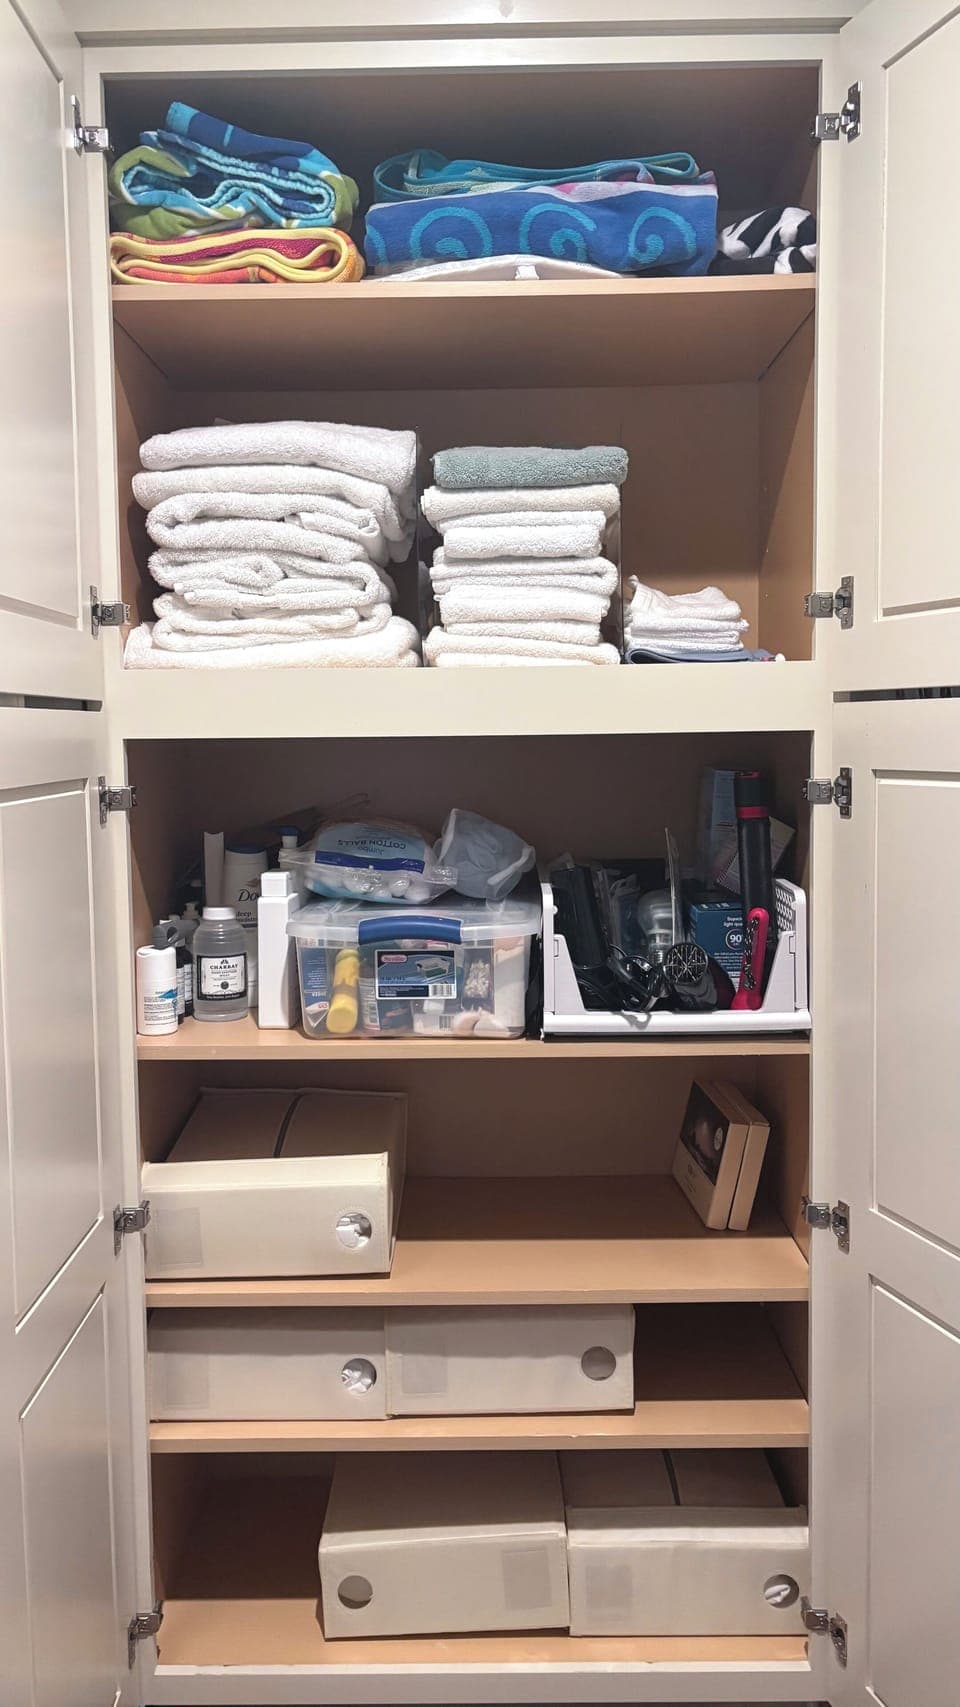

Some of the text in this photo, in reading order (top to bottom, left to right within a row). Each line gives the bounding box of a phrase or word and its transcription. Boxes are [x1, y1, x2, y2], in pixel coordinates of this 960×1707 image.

[337, 839, 407, 850] COTTON BALLS
[238, 889, 259, 901] Do
